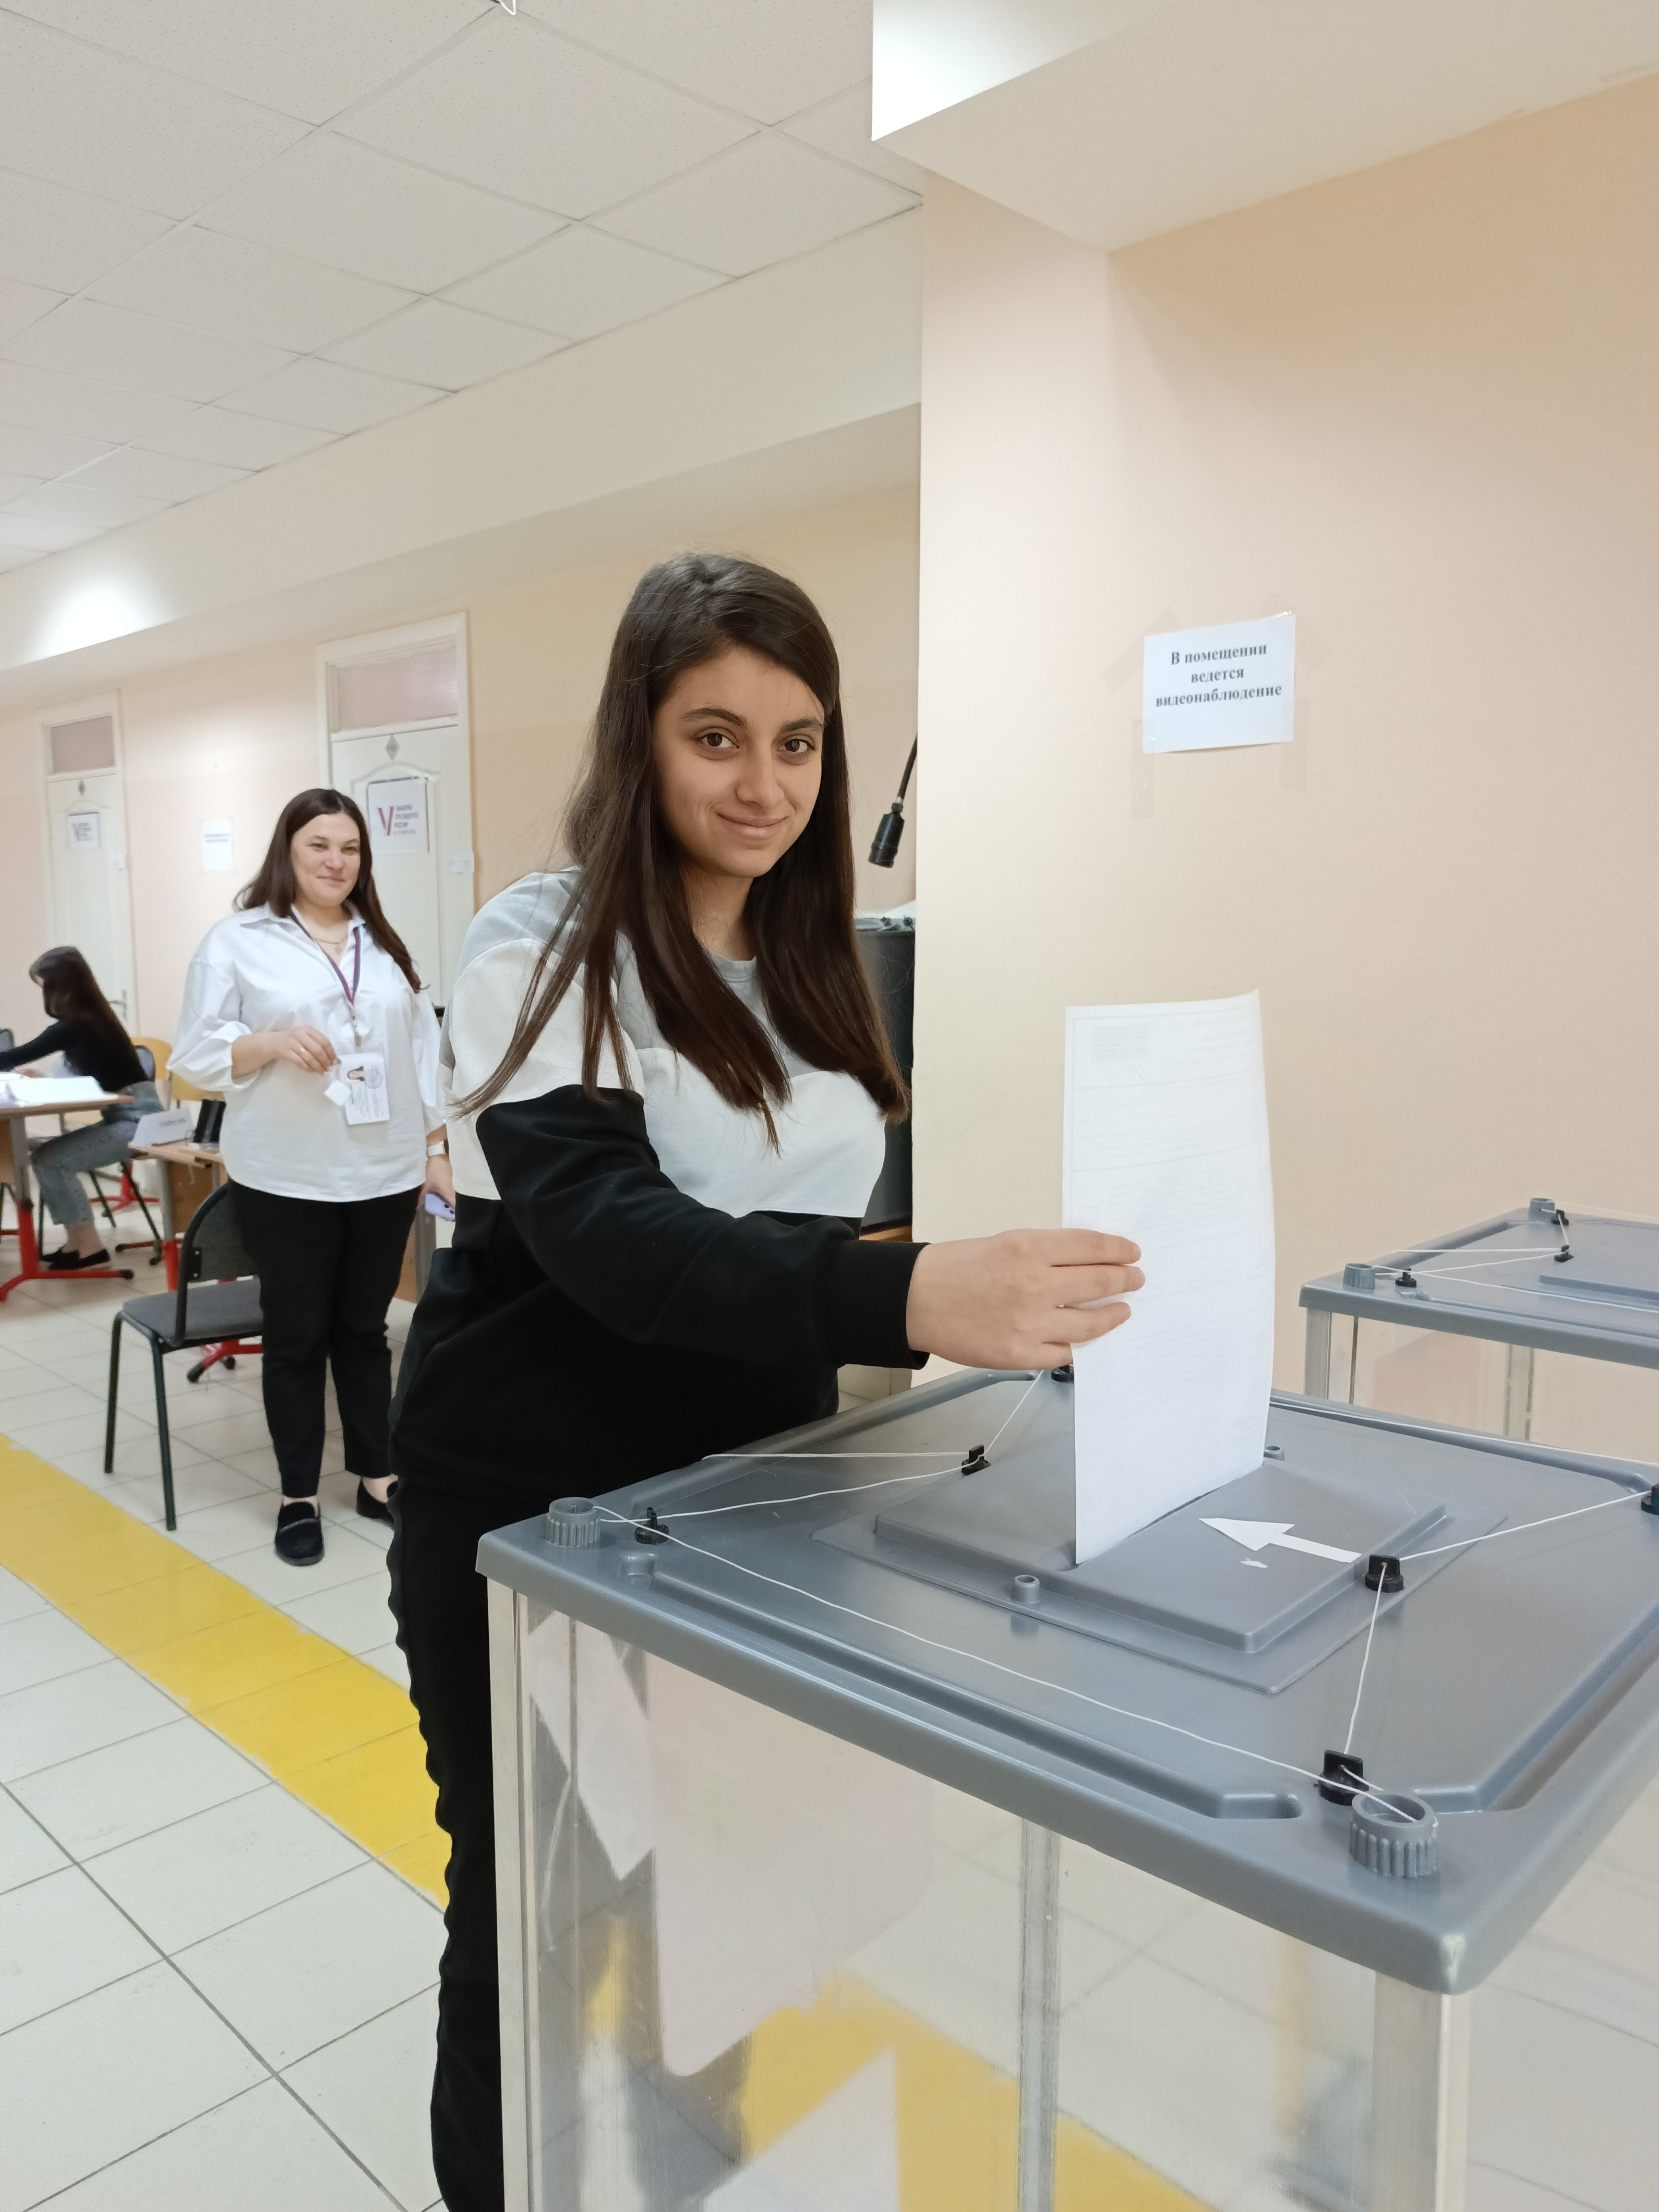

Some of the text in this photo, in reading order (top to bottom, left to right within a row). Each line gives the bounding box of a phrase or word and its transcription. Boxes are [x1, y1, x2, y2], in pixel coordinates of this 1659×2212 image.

[1170, 644, 1267, 665] В помещении
[1190, 668, 1244, 683] ведется
[1156, 685, 1282, 707] видеонаблюдение
